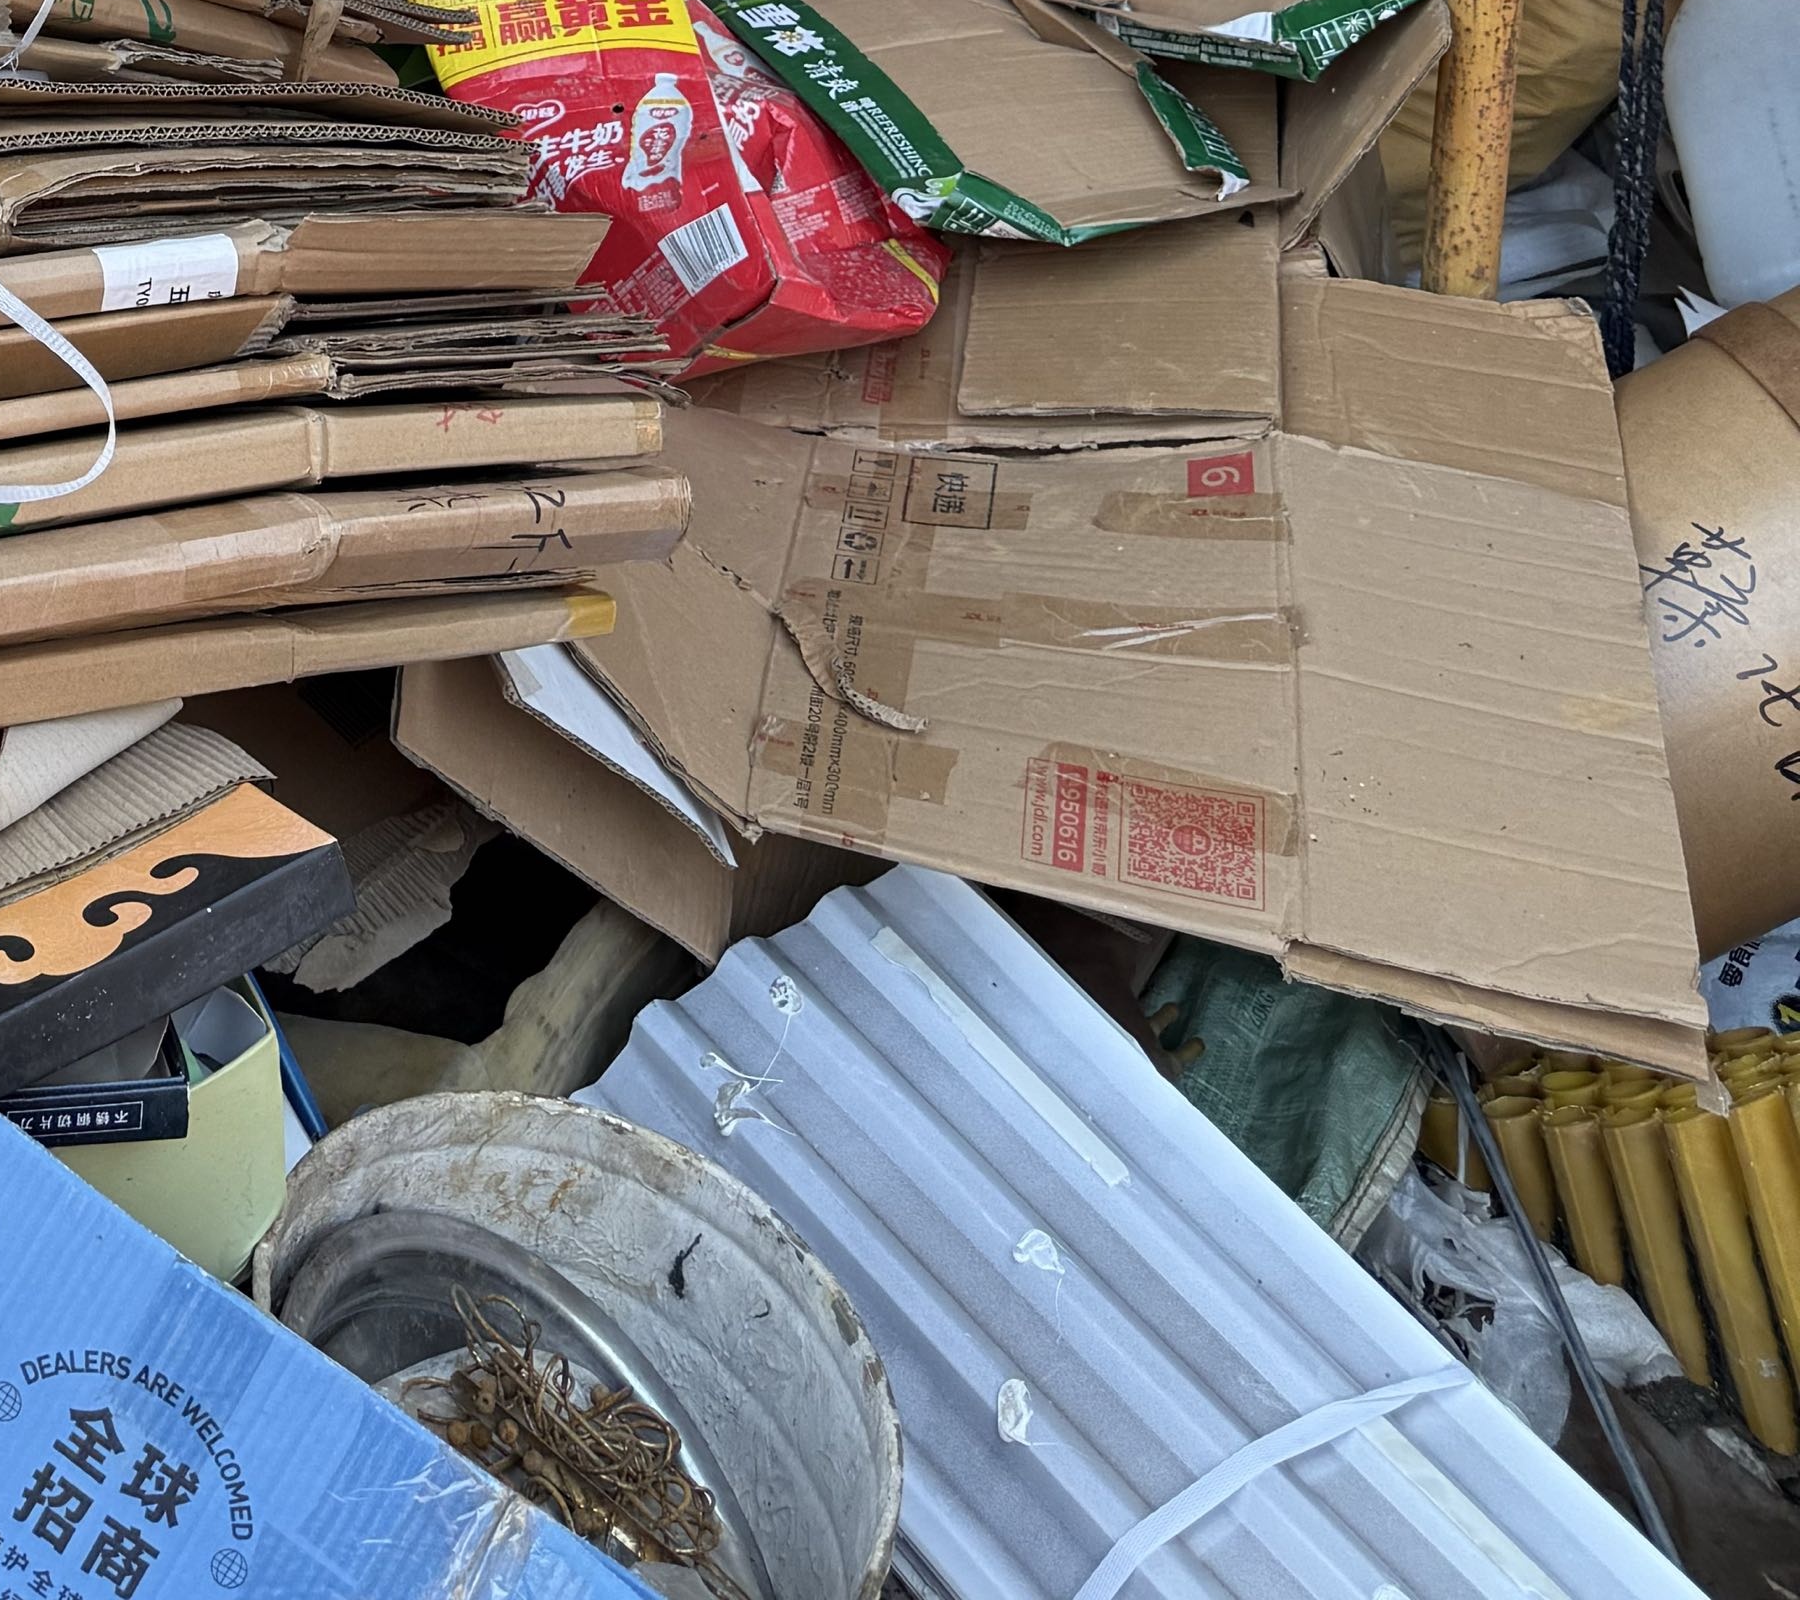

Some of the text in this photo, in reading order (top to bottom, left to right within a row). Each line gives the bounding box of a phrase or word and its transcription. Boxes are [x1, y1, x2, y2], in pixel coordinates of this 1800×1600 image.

[735, 2, 858, 103] 雪花 清爽
[931, 470, 968, 515] 快递
[1200, 463, 1241, 487] 6
[1028, 758, 1052, 857] www.jdl.com
[1053, 785, 1081, 865] 950616
[8, 1104, 133, 1135] 不锈钢切片刀
[19, 1349, 254, 1541] DEALERS ARE WELCOMED
[52, 1405, 201, 1529] 全球
[12, 1461, 160, 1599] 招商
